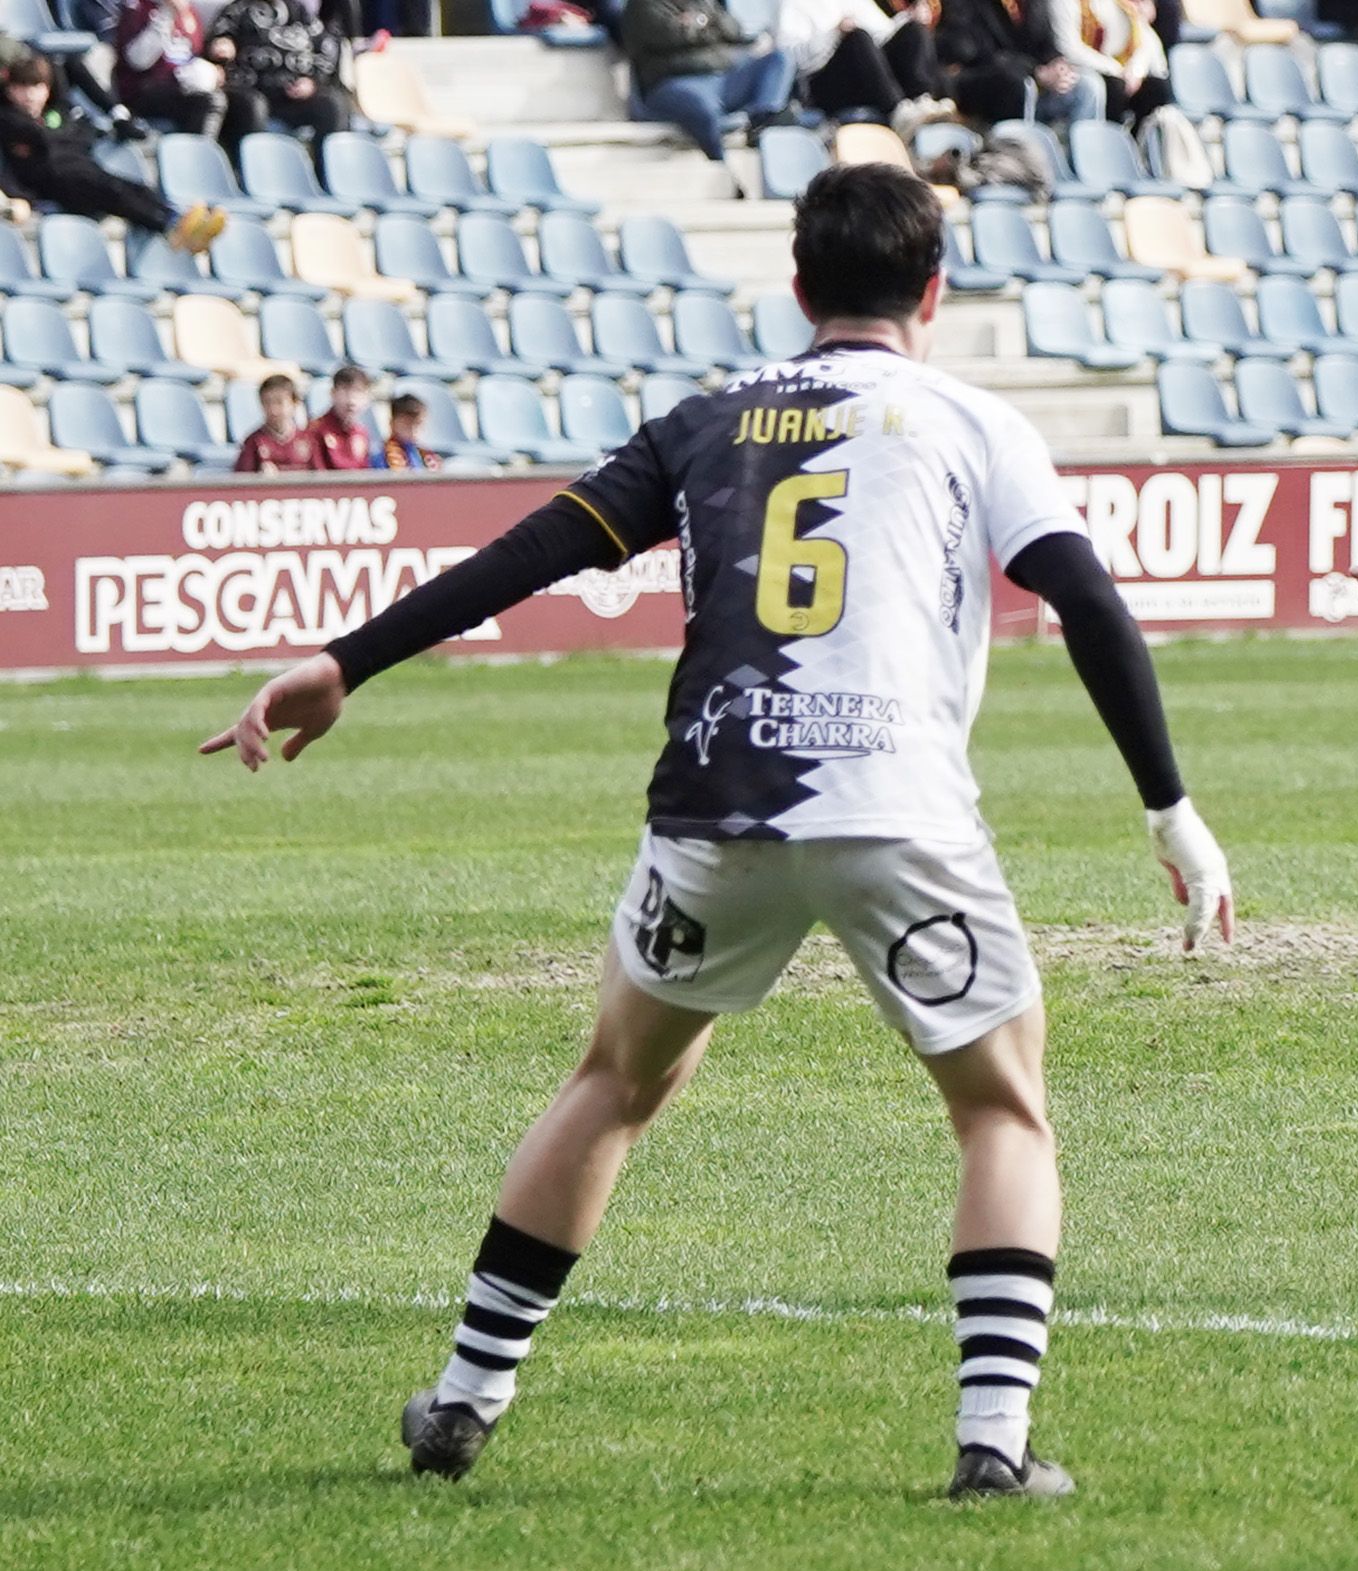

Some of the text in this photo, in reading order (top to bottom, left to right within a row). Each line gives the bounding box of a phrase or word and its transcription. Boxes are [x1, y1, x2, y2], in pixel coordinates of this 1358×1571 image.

[733, 404, 868, 445] JUANJE
[183, 496, 398, 549] CONSERVAS
[756, 468, 849, 637] 6
[743, 687, 904, 725] TERNERA
[750, 718, 896, 753] CHARRA
